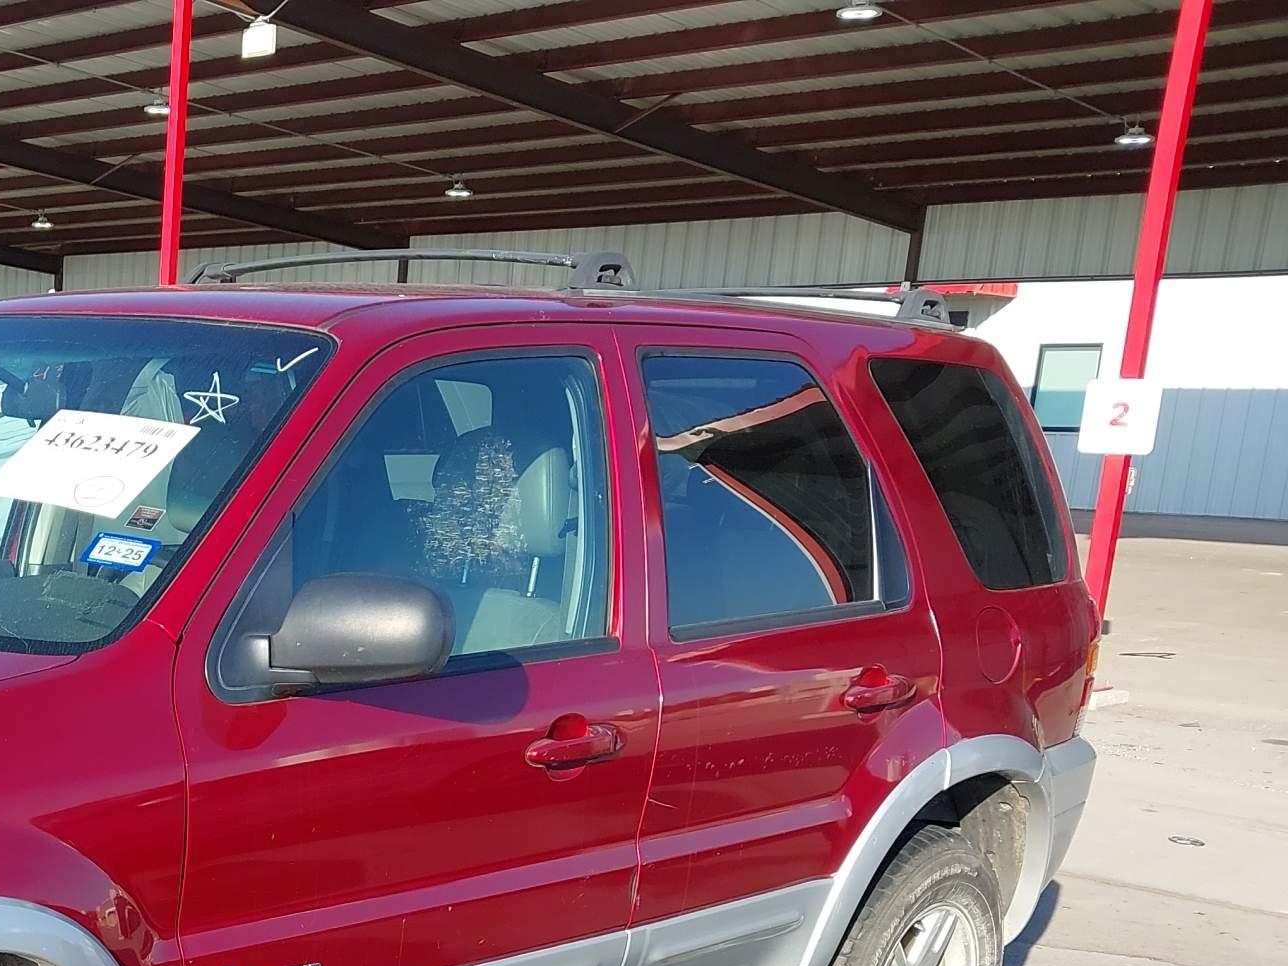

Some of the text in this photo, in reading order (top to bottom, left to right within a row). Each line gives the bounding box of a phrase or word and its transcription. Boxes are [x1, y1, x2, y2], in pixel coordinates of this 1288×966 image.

[1109, 402, 1130, 426] 2
[44, 431, 159, 459] 43623479
[96, 544, 144, 561] 12 25
